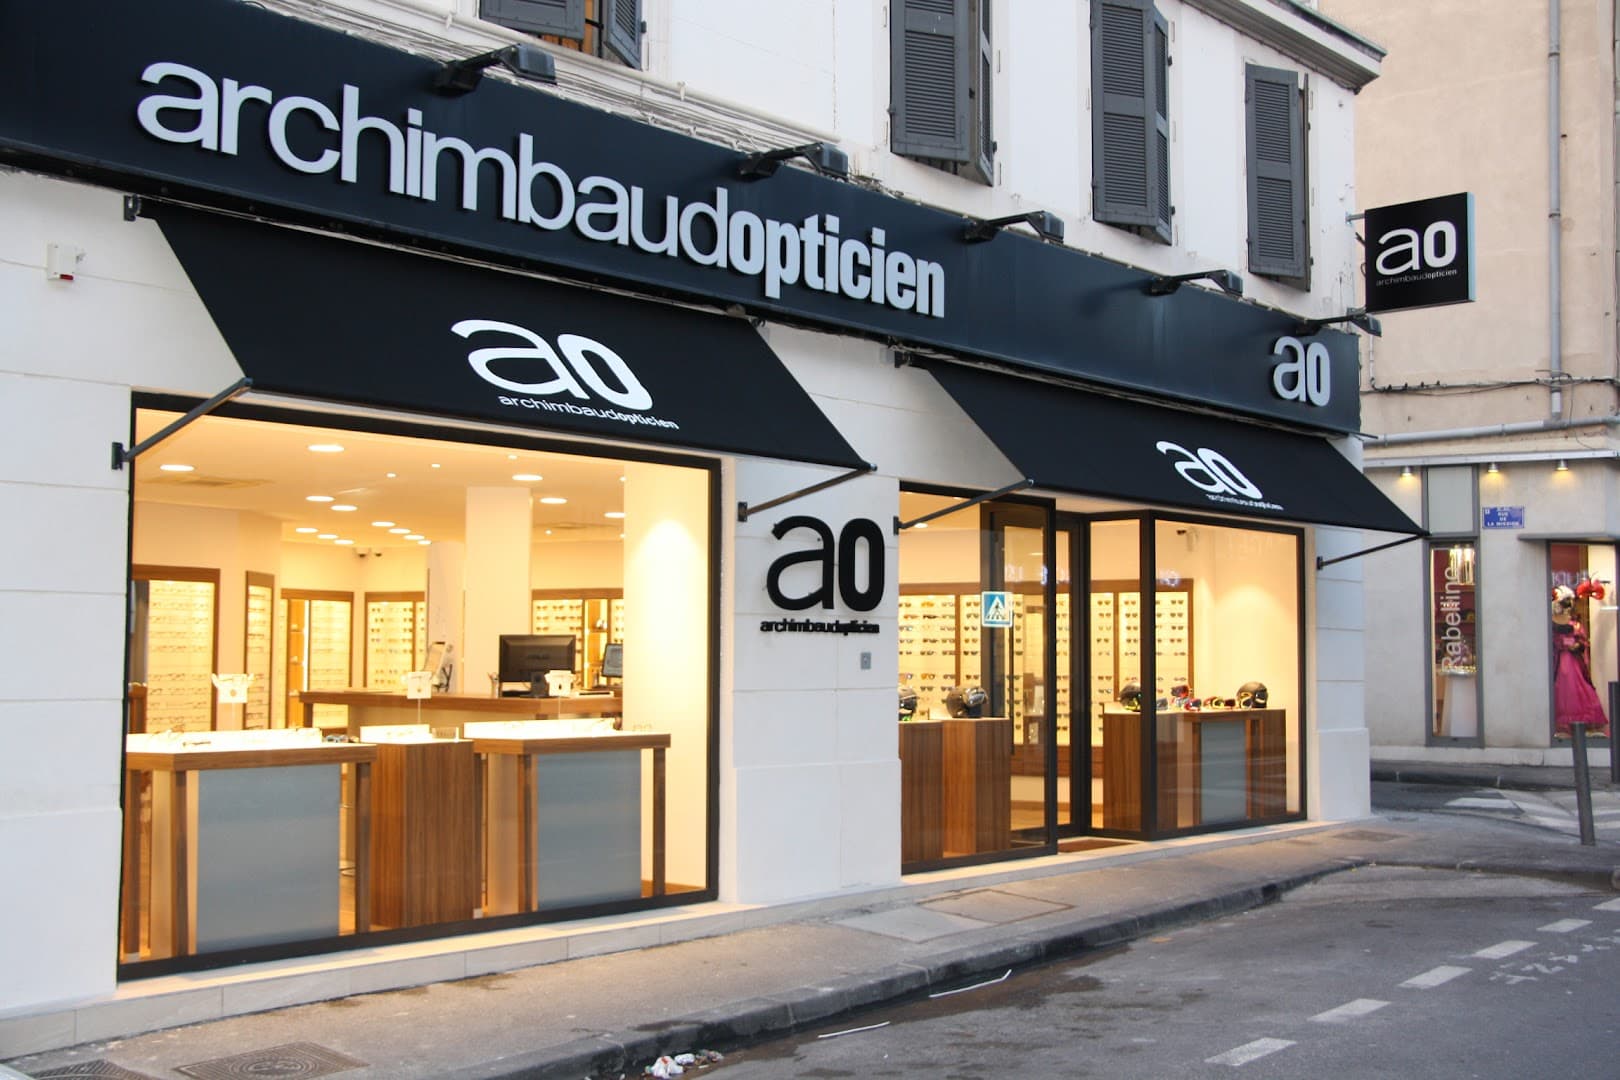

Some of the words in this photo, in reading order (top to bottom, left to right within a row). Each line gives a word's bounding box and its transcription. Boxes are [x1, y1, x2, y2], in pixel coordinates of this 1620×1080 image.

[1376, 220, 1457, 276] ao
[451, 319, 653, 411] ao
[1273, 335, 1331, 407] ao
[1156, 440, 1263, 500] ao
[766, 515, 885, 612] ao
